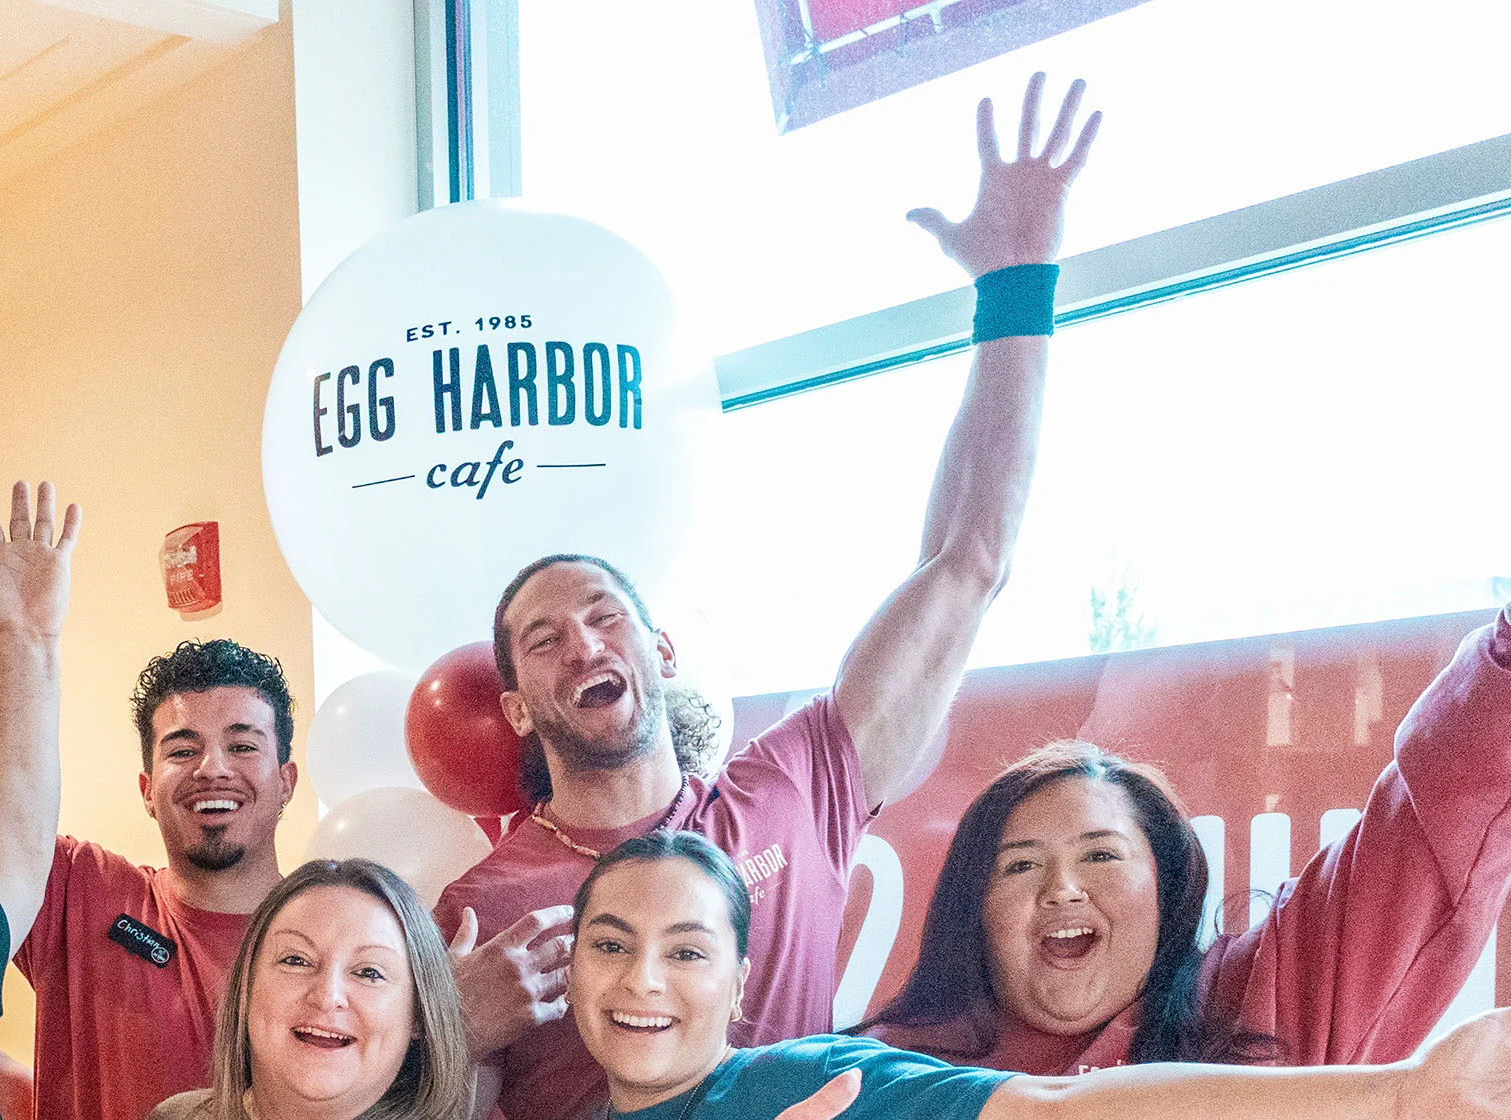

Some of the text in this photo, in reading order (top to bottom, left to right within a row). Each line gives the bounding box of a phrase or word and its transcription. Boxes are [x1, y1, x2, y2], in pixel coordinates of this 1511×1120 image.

[406, 315, 532, 342] EST. 1985
[313, 340, 642, 457] EGG HARBOR
[426, 439, 524, 500] cafe
[735, 844, 788, 888] ARBOR
[117, 919, 161, 949] Christian
